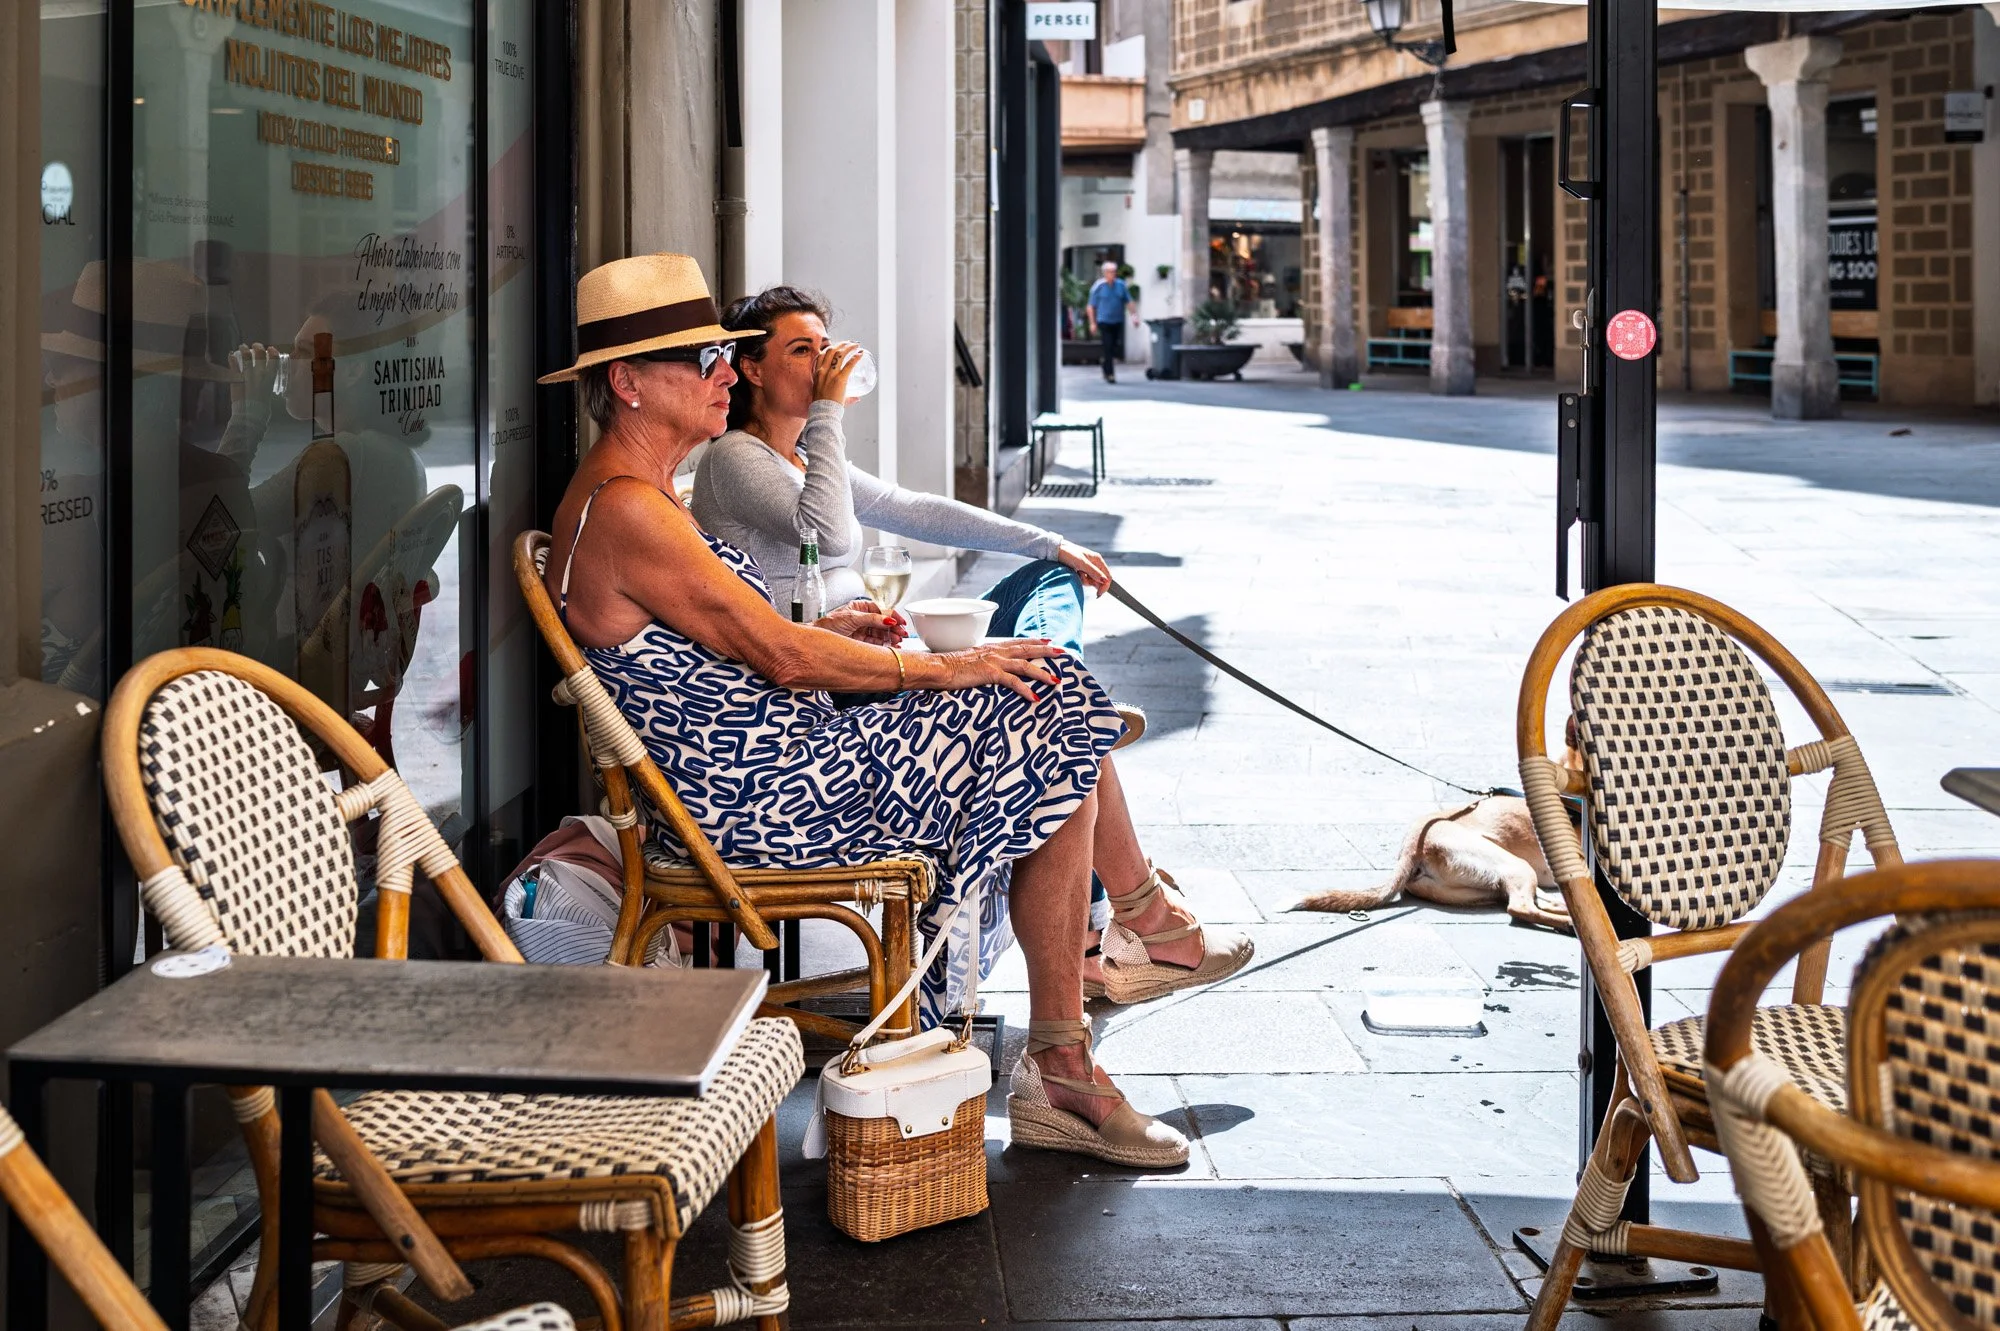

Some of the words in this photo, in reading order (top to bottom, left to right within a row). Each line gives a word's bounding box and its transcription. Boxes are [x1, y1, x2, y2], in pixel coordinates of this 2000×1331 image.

[1034, 14, 1089, 26] PERSEI
[184, 0, 335, 48] LEMENTE
[338, 10, 374, 58] LOS
[378, 24, 452, 82] MEJORES
[502, 40, 518, 58] 100%
[225, 37, 321, 102] MOJITOS
[323, 62, 361, 111] DEL
[363, 73, 423, 126] MUNDO
[495, 58, 510, 76] TRUE
[354, 232, 395, 281] Ahora
[358, 279, 372, 312] el
[423, 282, 434, 311] de
[436, 282, 459, 313] Cuba
[374, 355, 445, 386] SANTISIMA
[380, 383, 441, 415] TRINIDAD
